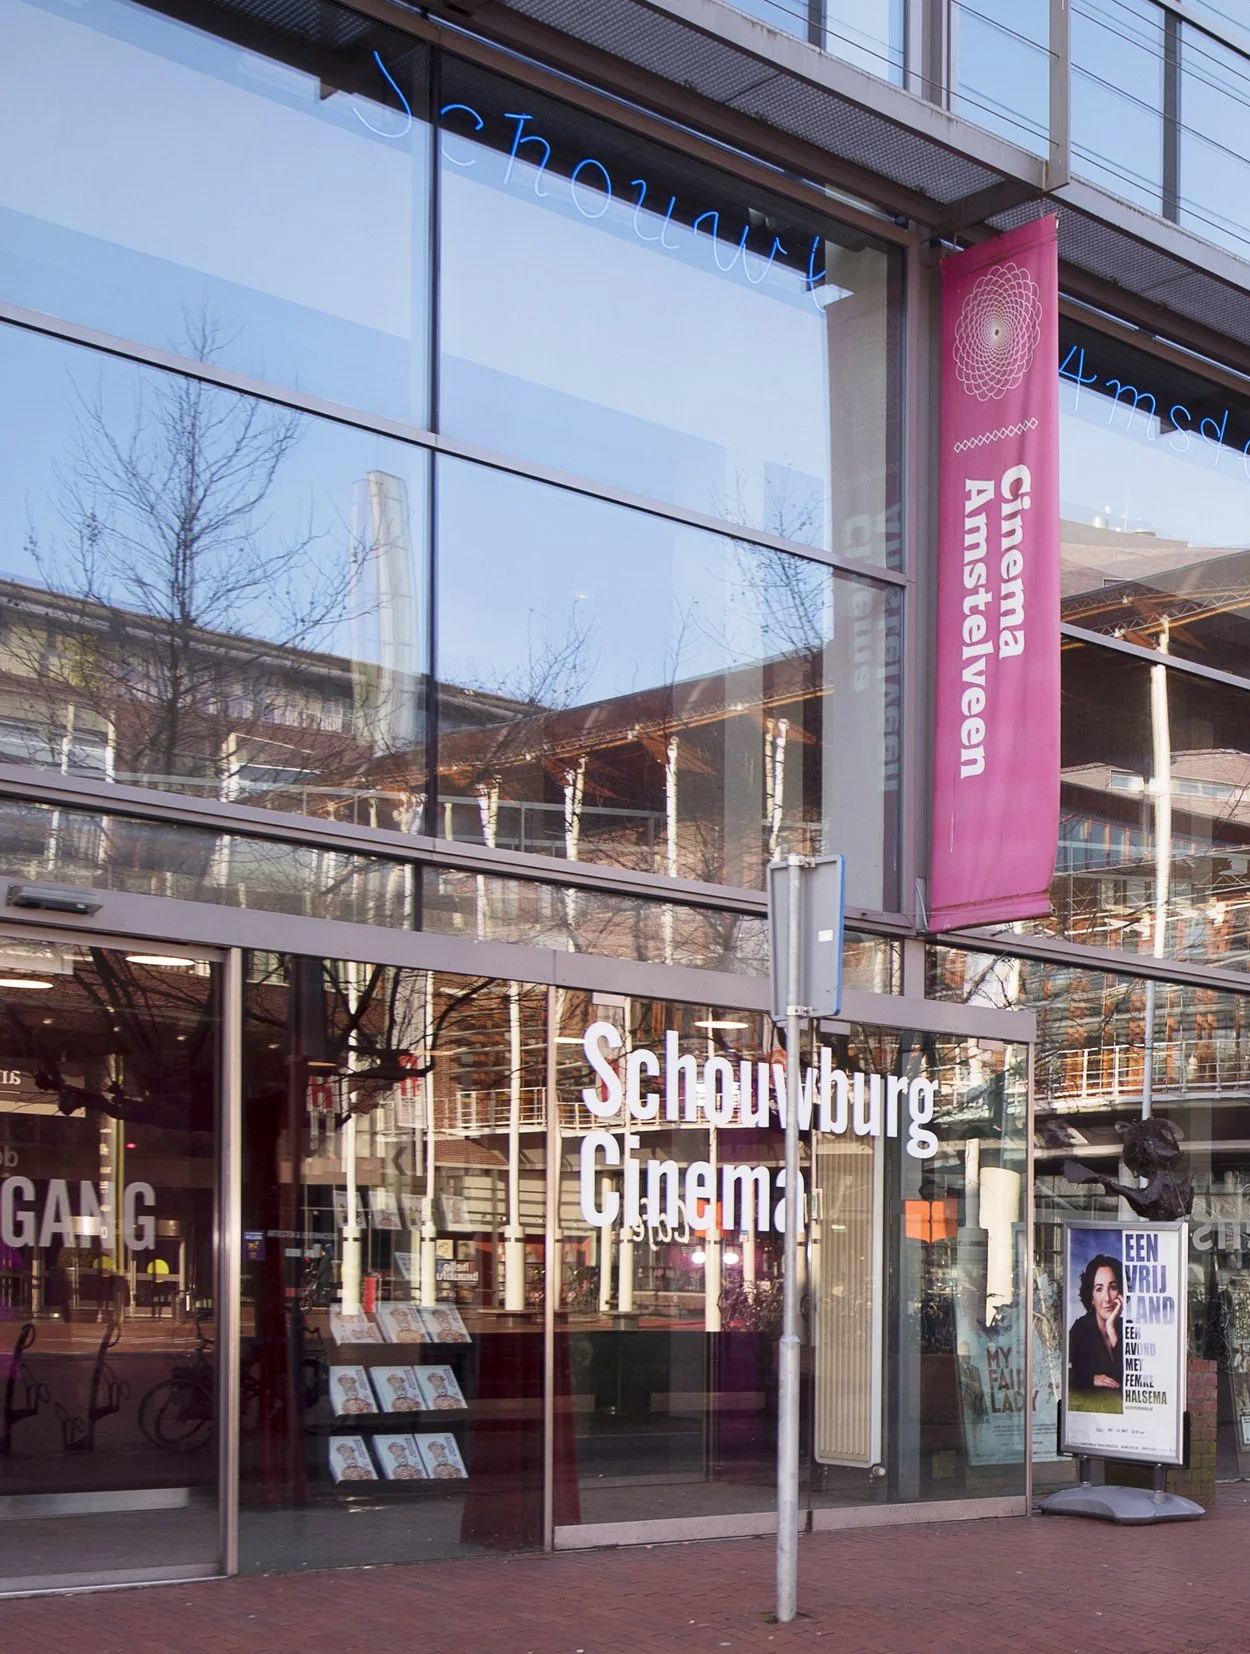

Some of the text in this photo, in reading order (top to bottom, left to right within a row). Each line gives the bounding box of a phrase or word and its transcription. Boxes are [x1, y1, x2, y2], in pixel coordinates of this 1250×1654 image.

[999, 463, 1032, 661] Cinema
[960, 478, 996, 780] Amstelveen
[582, 1021, 940, 1160] Schouwburg
[579, 1130, 806, 1233] Cinema
[0, 1175, 157, 1251] GANG
[1125, 1233, 1159, 1263] EEN
[1124, 1264, 1167, 1294] VRIJ
[1125, 1295, 1175, 1325] LAND
[1125, 1326, 1141, 1340] EEN
[986, 1346, 1013, 1369] MY
[1124, 1342, 1156, 1357] AVOND
[1125, 1357, 1144, 1372] MET
[1124, 1373, 1155, 1388] FEMKE
[1124, 1388, 1168, 1405] HALSEMA
